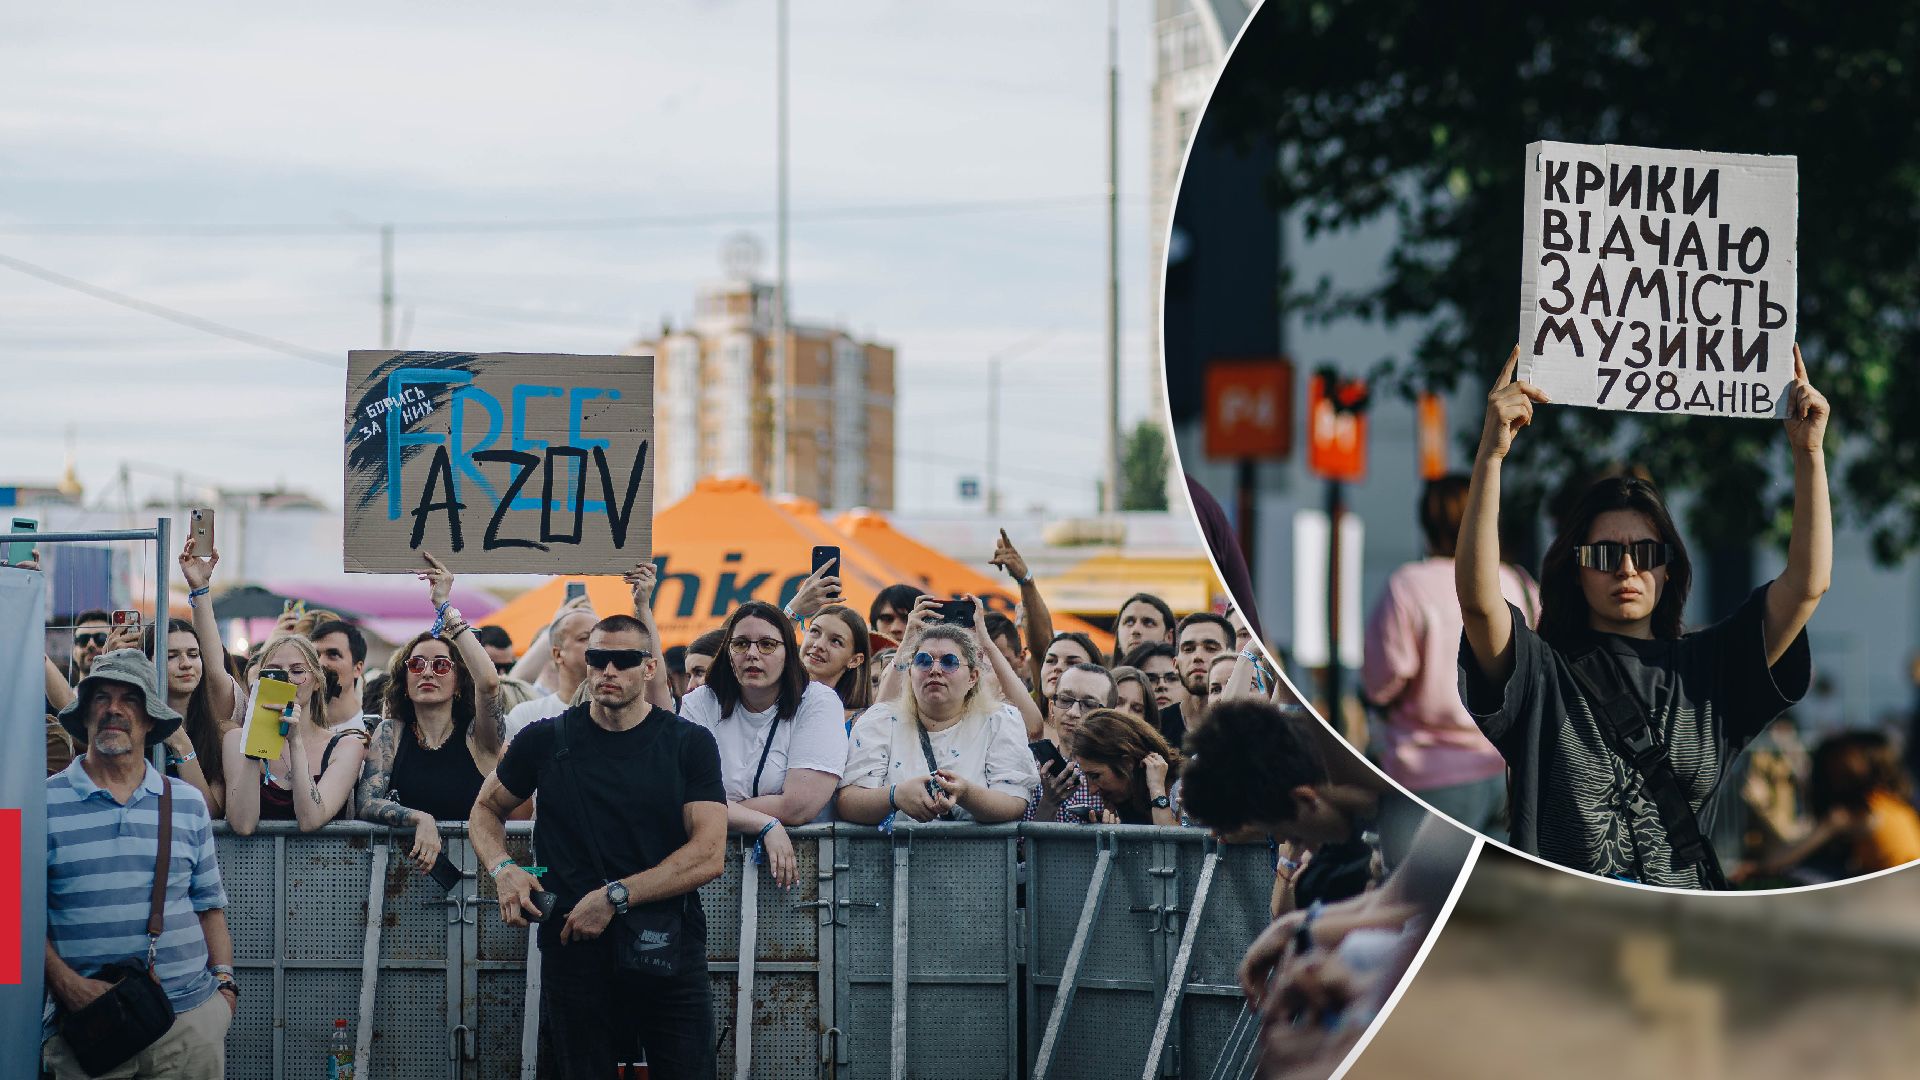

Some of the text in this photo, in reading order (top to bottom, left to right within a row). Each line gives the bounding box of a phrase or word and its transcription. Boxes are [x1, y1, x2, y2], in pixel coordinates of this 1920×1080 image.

[1544, 160, 1719, 219] КРИКИ
[1543, 208, 1770, 274] ВІДЧАЮ
[1539, 252, 1788, 330] ЗАМІСТЬ
[1533, 316, 1769, 373] МУЗИКИ
[359, 399, 434, 441] ЗА НИХ
[365, 386, 426, 419] БОРИСЬ
[387, 367, 622, 521] FREE
[410, 439, 648, 553] AZOV
